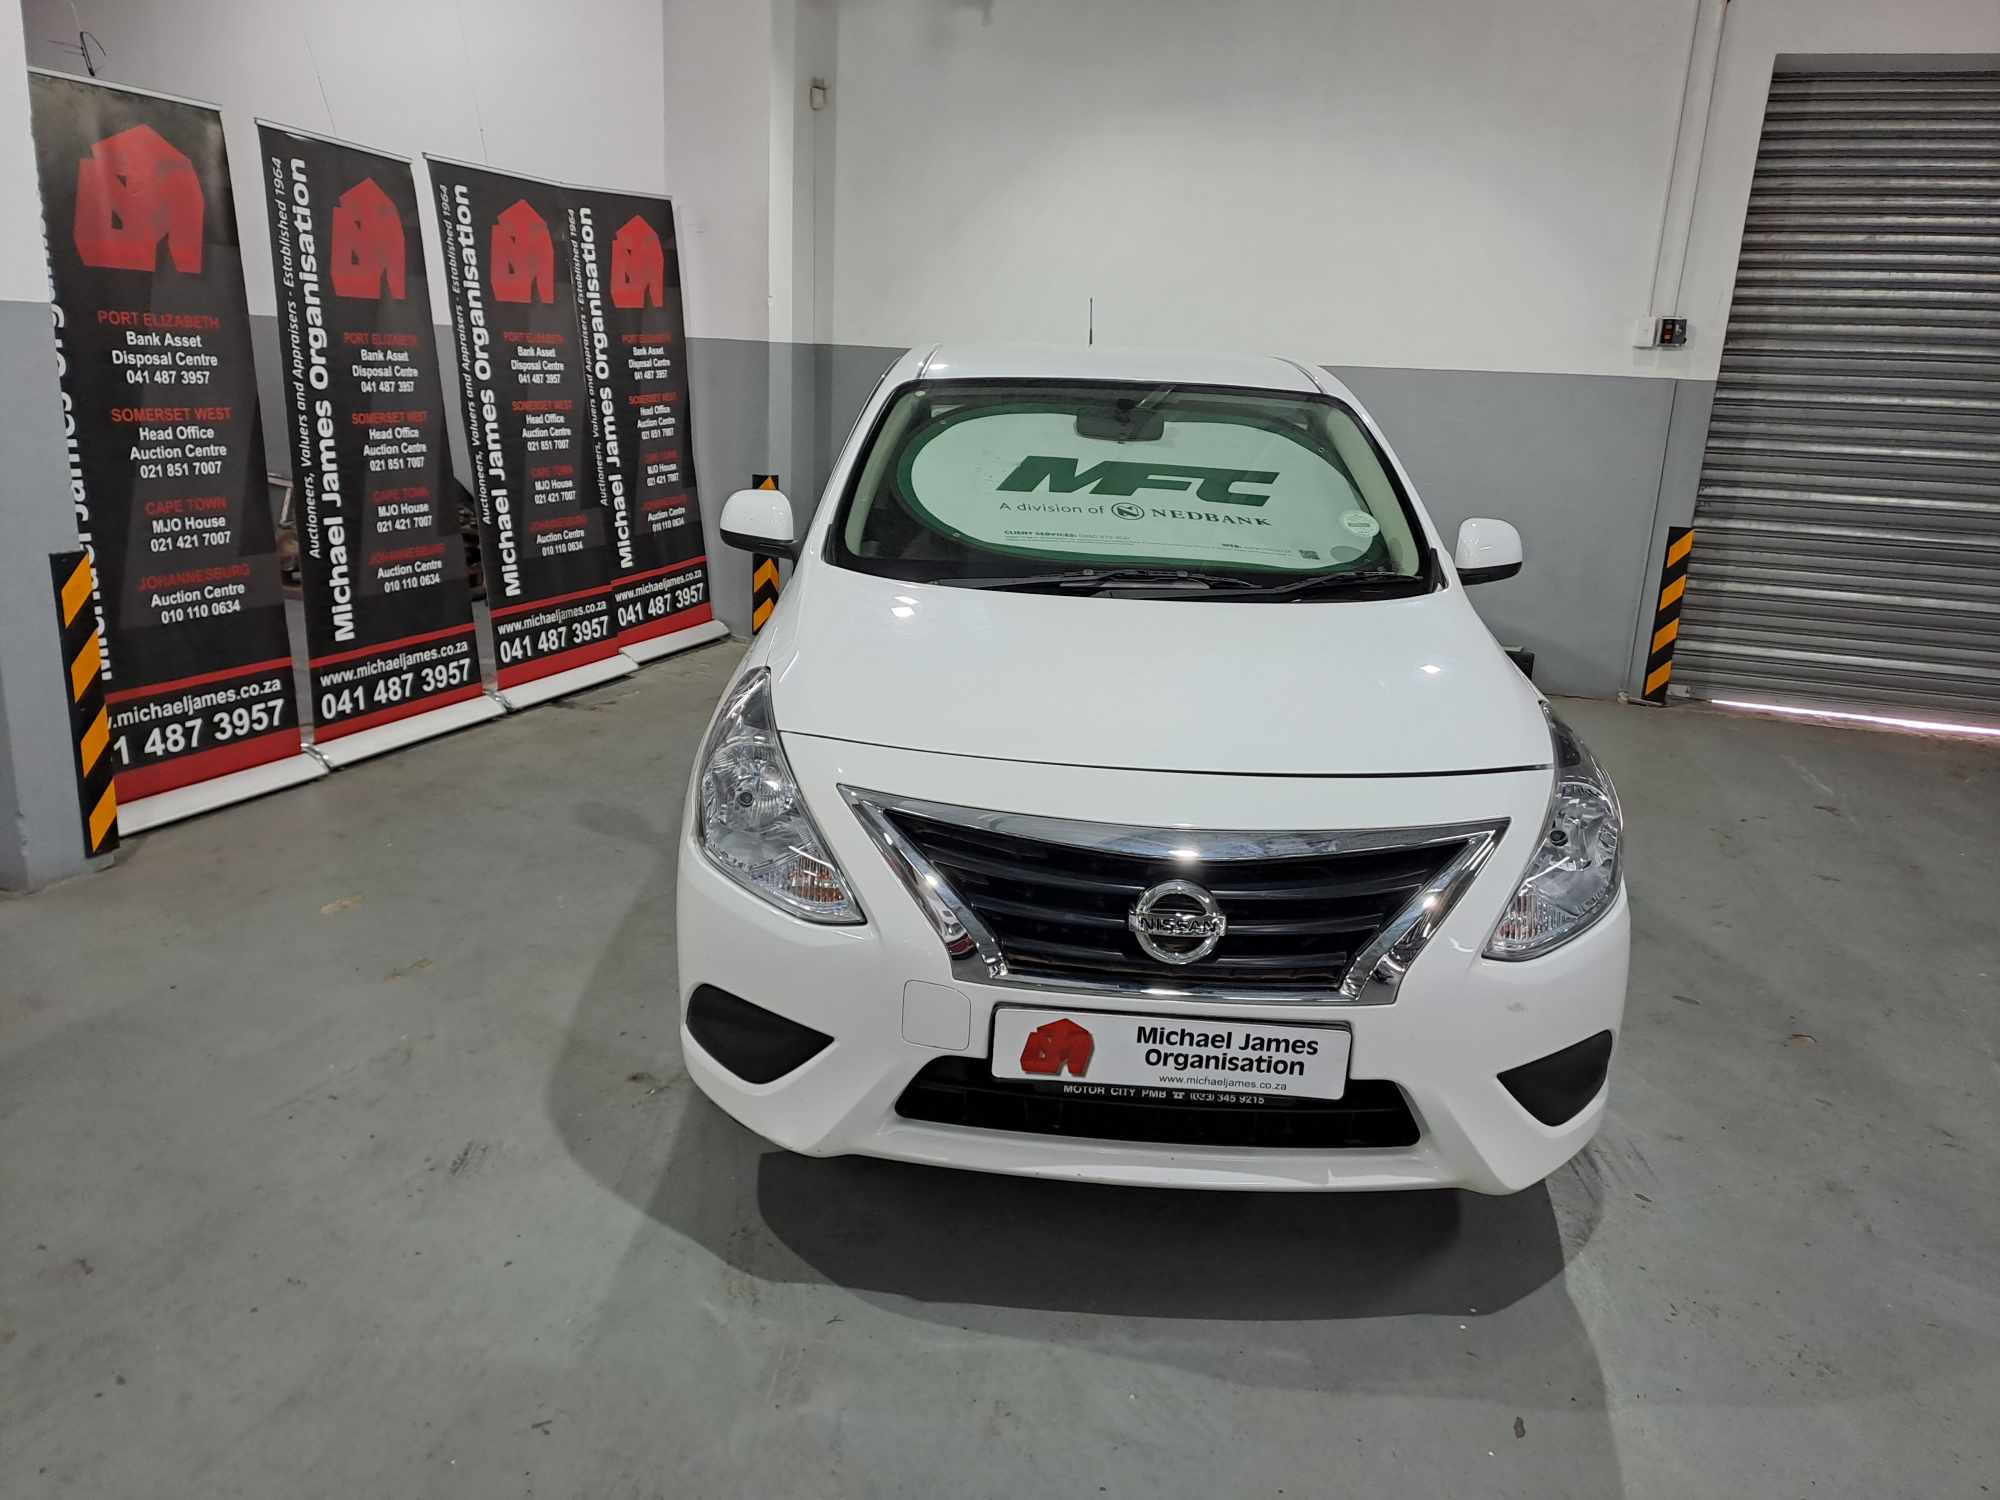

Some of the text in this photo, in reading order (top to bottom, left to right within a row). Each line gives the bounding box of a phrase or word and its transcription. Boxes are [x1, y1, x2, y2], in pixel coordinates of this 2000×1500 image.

[272, 156, 283, 195] 1964
[440, 184, 449, 215] 1964
[275, 199, 294, 288] Established
[443, 218, 461, 293] Established
[98, 310, 219, 329] PORT ELIZABETH
[126, 331, 202, 348] Bank Asset
[287, 301, 305, 378] Appraisers
[456, 304, 470, 371] Appraisers
[112, 350, 218, 369] Disposal Centre
[361, 349, 409, 362] Bank Asset
[126, 370, 210, 385] 041 487 3957
[352, 365, 418, 380] Disposal Centre
[361, 381, 414, 393] 041 487 3957
[454, 184, 521, 597] Michael James Organisation
[290, 158, 355, 642] Michael James Organisation
[111, 407, 231, 423] SOMERSET WEST
[468, 400, 480, 446] Valuers
[139, 426, 214, 441] Head Office
[298, 415, 311, 467] Valuers
[369, 427, 419, 440] Head Office
[130, 443, 227, 461] Auction Centre
[363, 443, 427, 457] Auction Centre
[140, 460, 222, 478] 021 851 7007
[370, 456, 424, 472] 021 851 7007
[475, 451, 492, 525] Auctioneers,
[995, 456, 1280, 507] MFC
[146, 496, 227, 515] CAPE TOWN
[304, 472, 321, 559] Auctioneers,
[378, 503, 429, 517] MJO House
[1000, 502, 1273, 527] A division of NEDBANK
[152, 515, 225, 534] MJO House
[377, 516, 432, 533] 021 421 7007
[151, 531, 231, 552] 021 421 7007
[139, 564, 250, 590] JOHANNESBURG
[377, 560, 442, 580] Auction Centre
[384, 574, 440, 593] 010 110 0634
[151, 582, 245, 608] Auction Centre
[161, 600, 240, 624] 010 110 0634
[498, 600, 607, 635] www.michaeljames.co.za
[500, 616, 609, 663] 041 487 3957
[320, 641, 468, 687] www.michaeljames.co.za
[321, 658, 471, 719] 041 487 3957
[144, 719, 203, 757] 487
[214, 699, 284, 741] 3957
[1140, 918, 1217, 932] NISSAN
[1136, 1026, 1319, 1056] Michael James
[1144, 1049, 1305, 1077] Organisation
[1063, 1085, 1105, 1097] MOTOR
[1110, 1087, 1136, 1097] CITY
[1142, 1088, 1166, 1099] PMB
[1159, 1074, 1288, 1091] www.michaeljames.co.za
